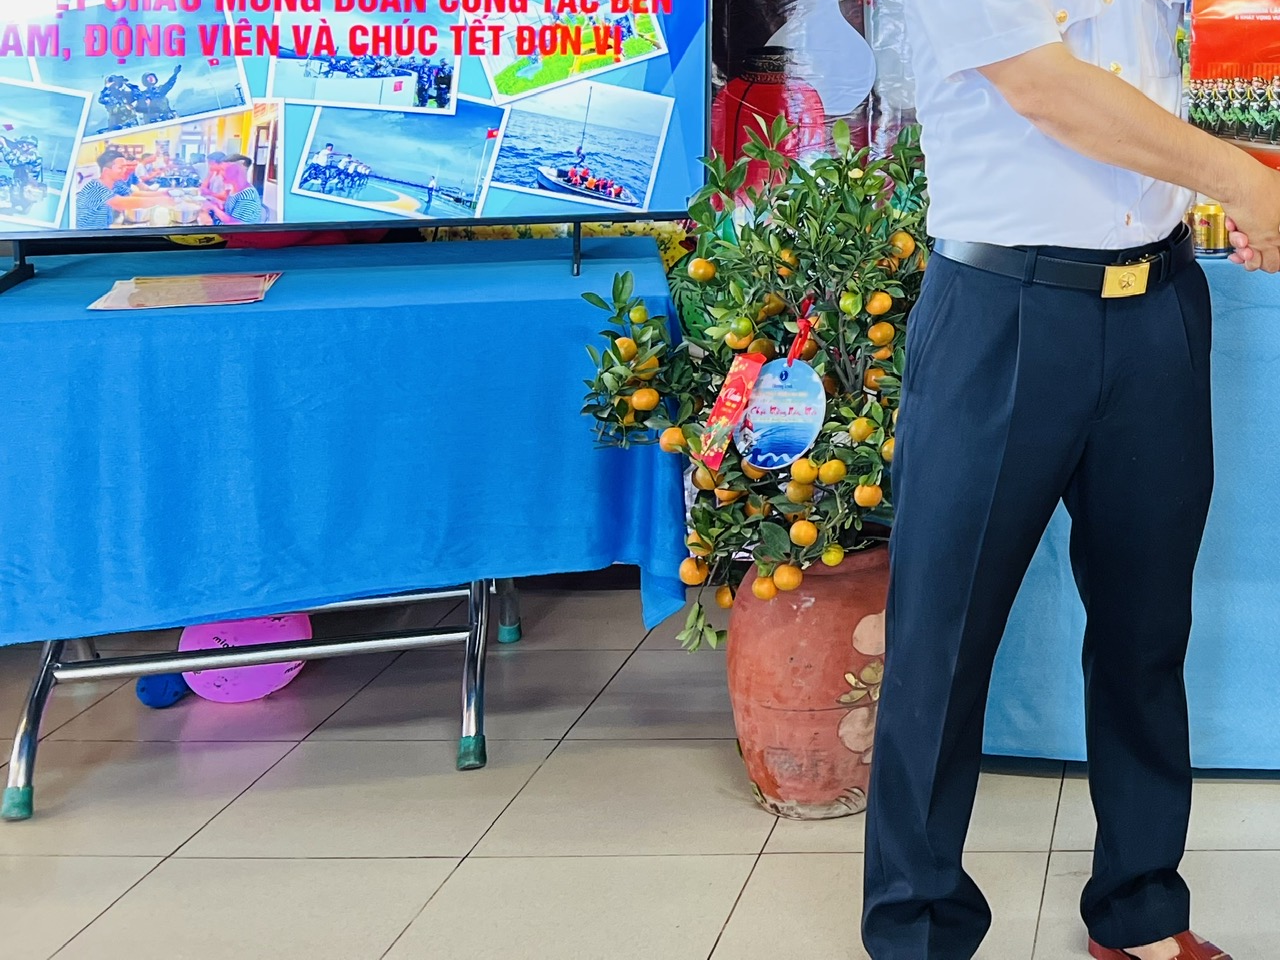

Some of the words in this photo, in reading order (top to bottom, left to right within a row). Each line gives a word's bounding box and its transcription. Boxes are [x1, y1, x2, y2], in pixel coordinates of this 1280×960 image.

[84, 17, 187, 64] ĐỘNG
[197, 17, 280, 58] VIÊN
[291, 18, 341, 57] VÀ
[348, 19, 438, 57] CHÚC
[450, 14, 505, 57] TẾT
[515, 23, 582, 57] ĐƠN
[593, 24, 622, 63] VỊ
